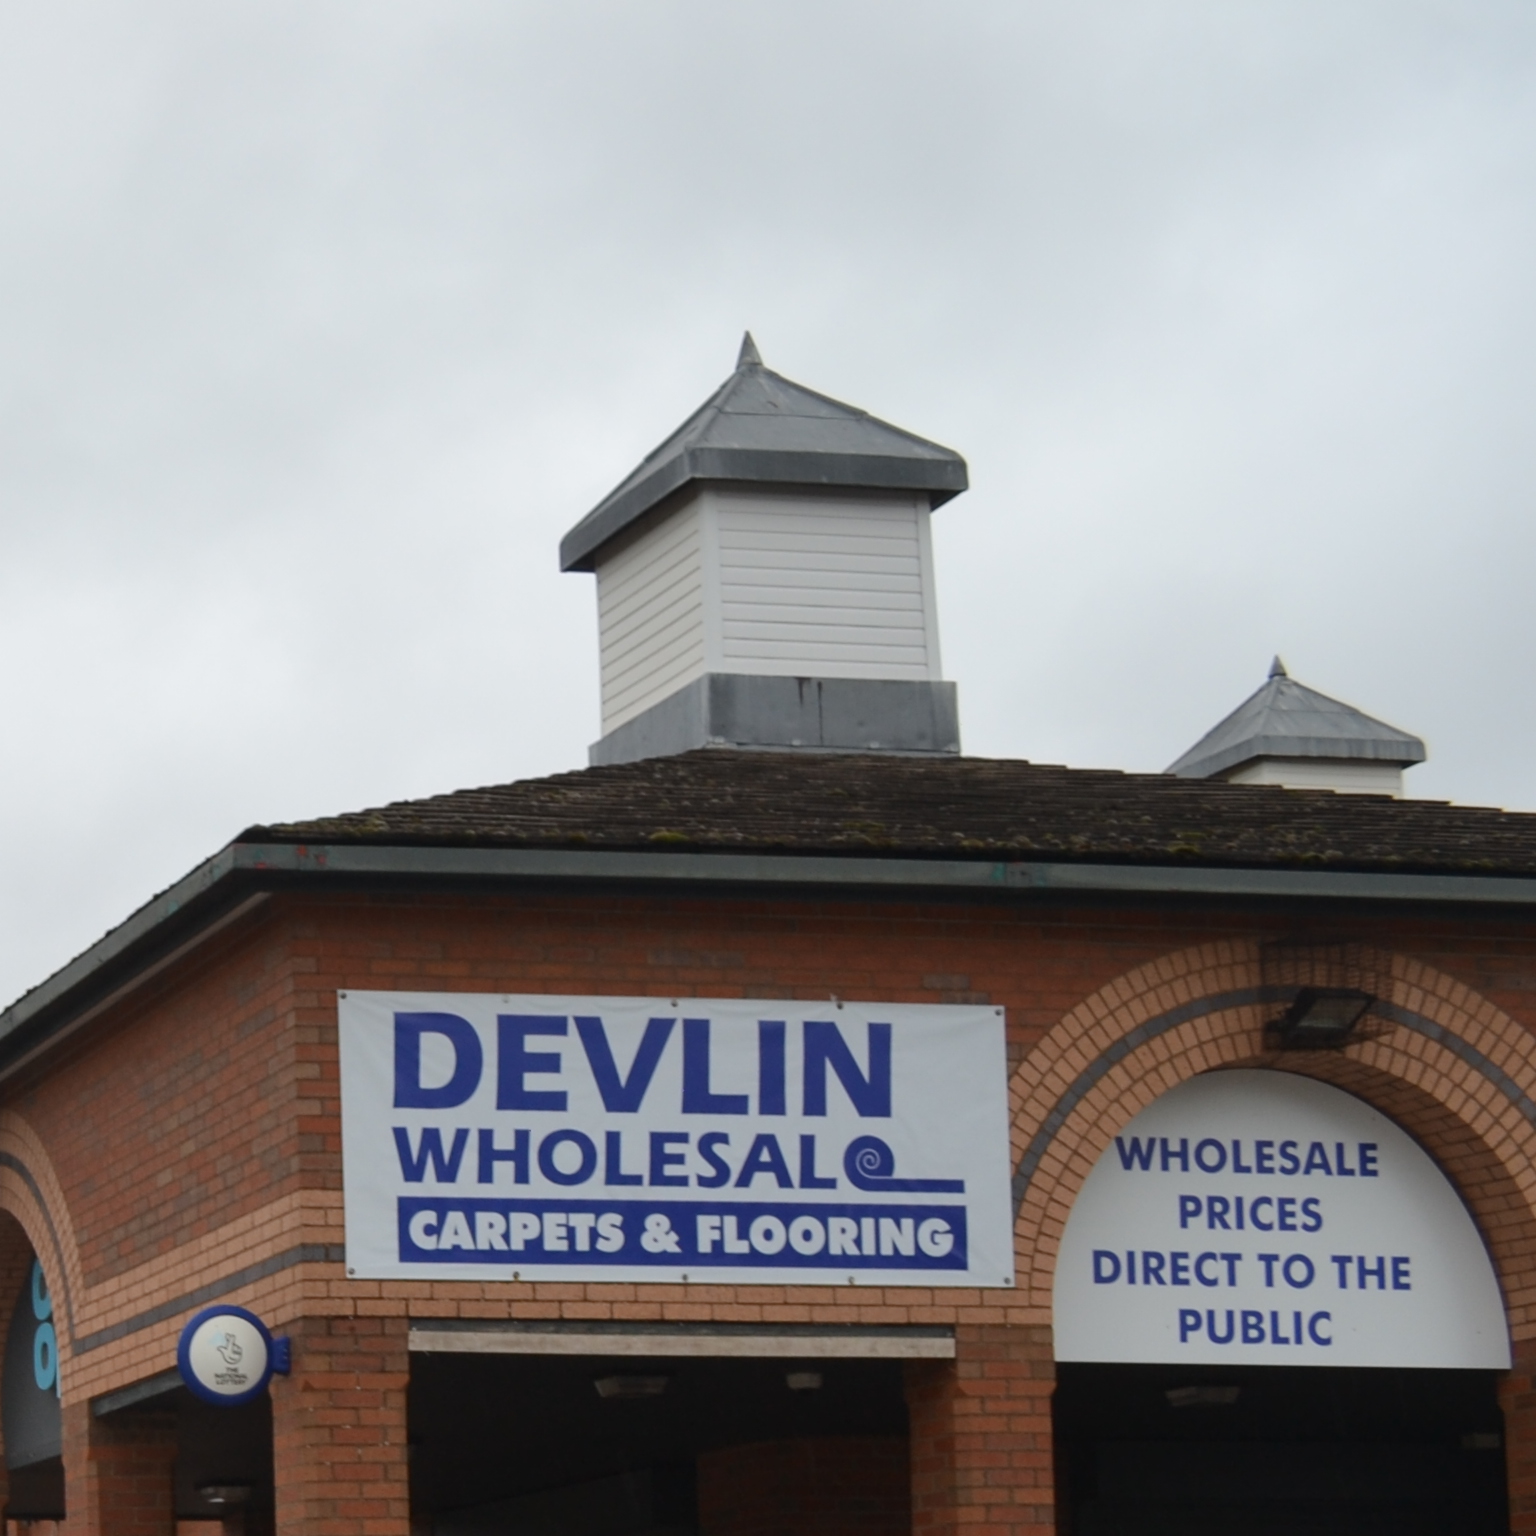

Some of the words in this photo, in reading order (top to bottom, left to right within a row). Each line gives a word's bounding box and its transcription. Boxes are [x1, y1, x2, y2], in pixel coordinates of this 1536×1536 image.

[392, 1011, 892, 1118] DEVLIN
[1115, 1136, 1379, 1177] WHOLESALE
[408, 1210, 625, 1253] CARPETS
[640, 1215, 682, 1254] &
[696, 1214, 954, 1258] FLOORING
[1178, 1195, 1324, 1232] PRICES
[1092, 1249, 1242, 1288] DIRECT
[1258, 1253, 1316, 1289] TO
[1331, 1255, 1411, 1291] THE
[1178, 1308, 1333, 1346] PUBLIC
